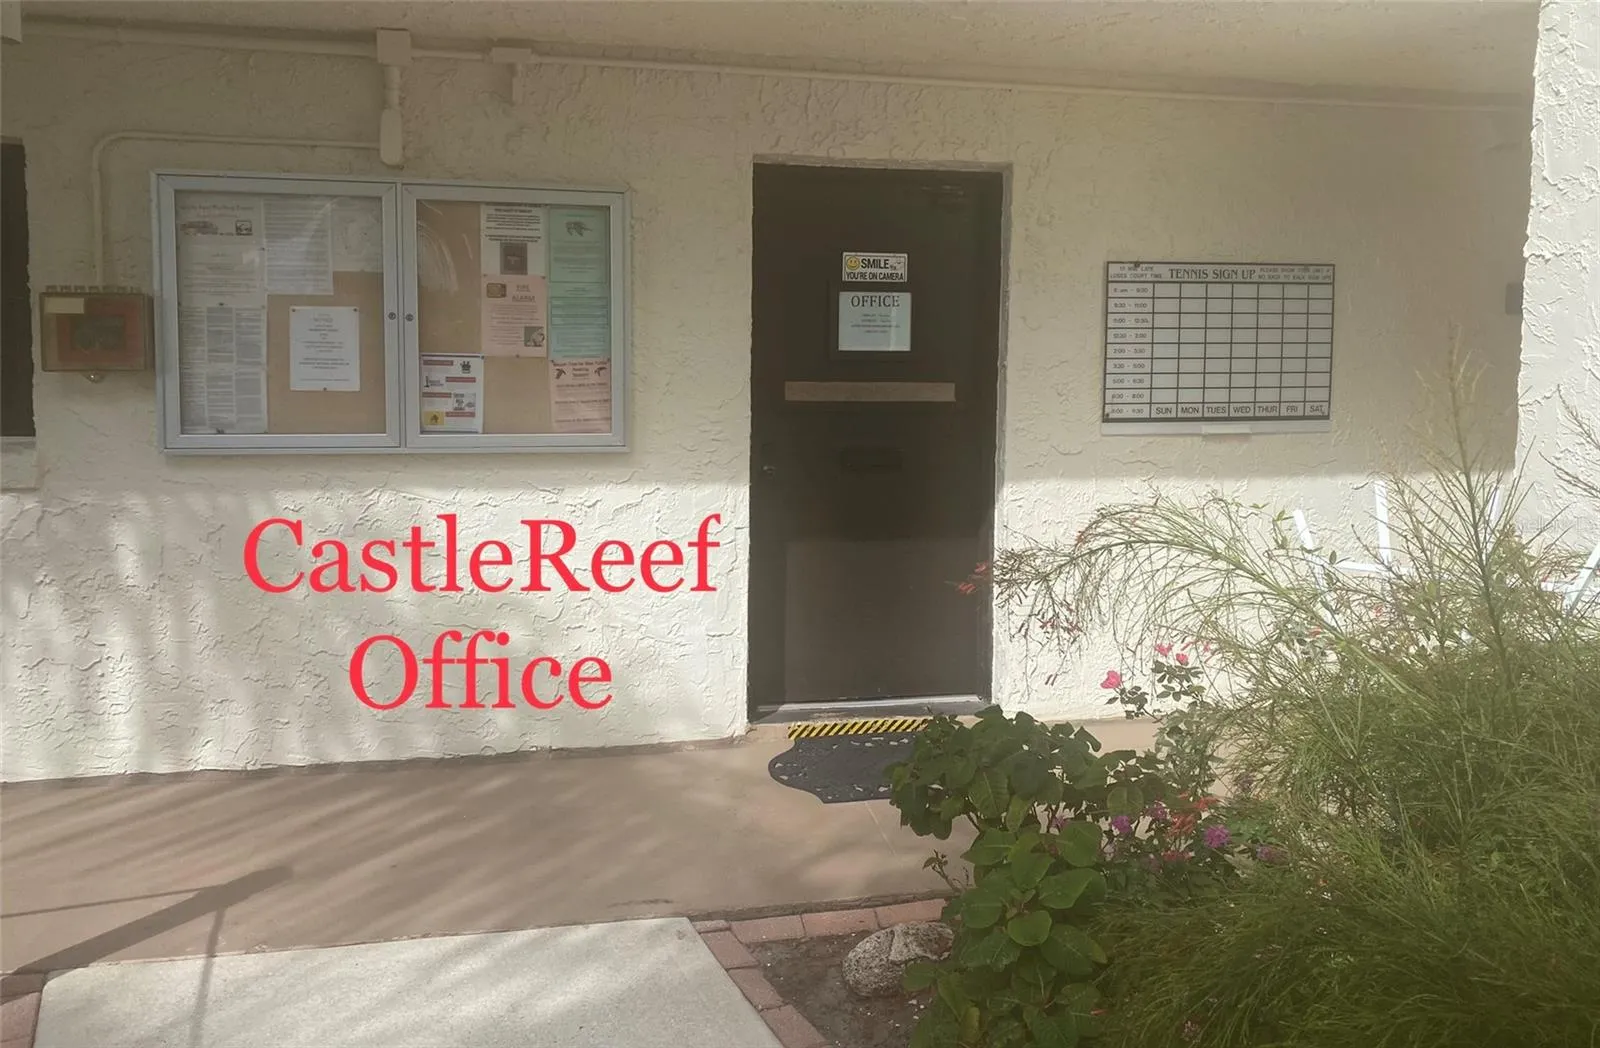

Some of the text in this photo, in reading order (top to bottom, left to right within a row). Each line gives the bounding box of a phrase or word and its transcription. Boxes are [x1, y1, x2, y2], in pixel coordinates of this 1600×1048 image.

[860, 258, 889, 270] SMILE
[845, 271, 904, 281] YOU'RE ON CAMERA
[1168, 268, 1256, 280] TENNIS SIGN UP
[850, 295, 900, 308] OFFICE
[1155, 406, 1173, 415] SUN
[1180, 406, 1200, 414] MON
[1206, 406, 1227, 414] TUES
[1286, 405, 1298, 413] FRI
[1309, 405, 1323, 413] SAT
